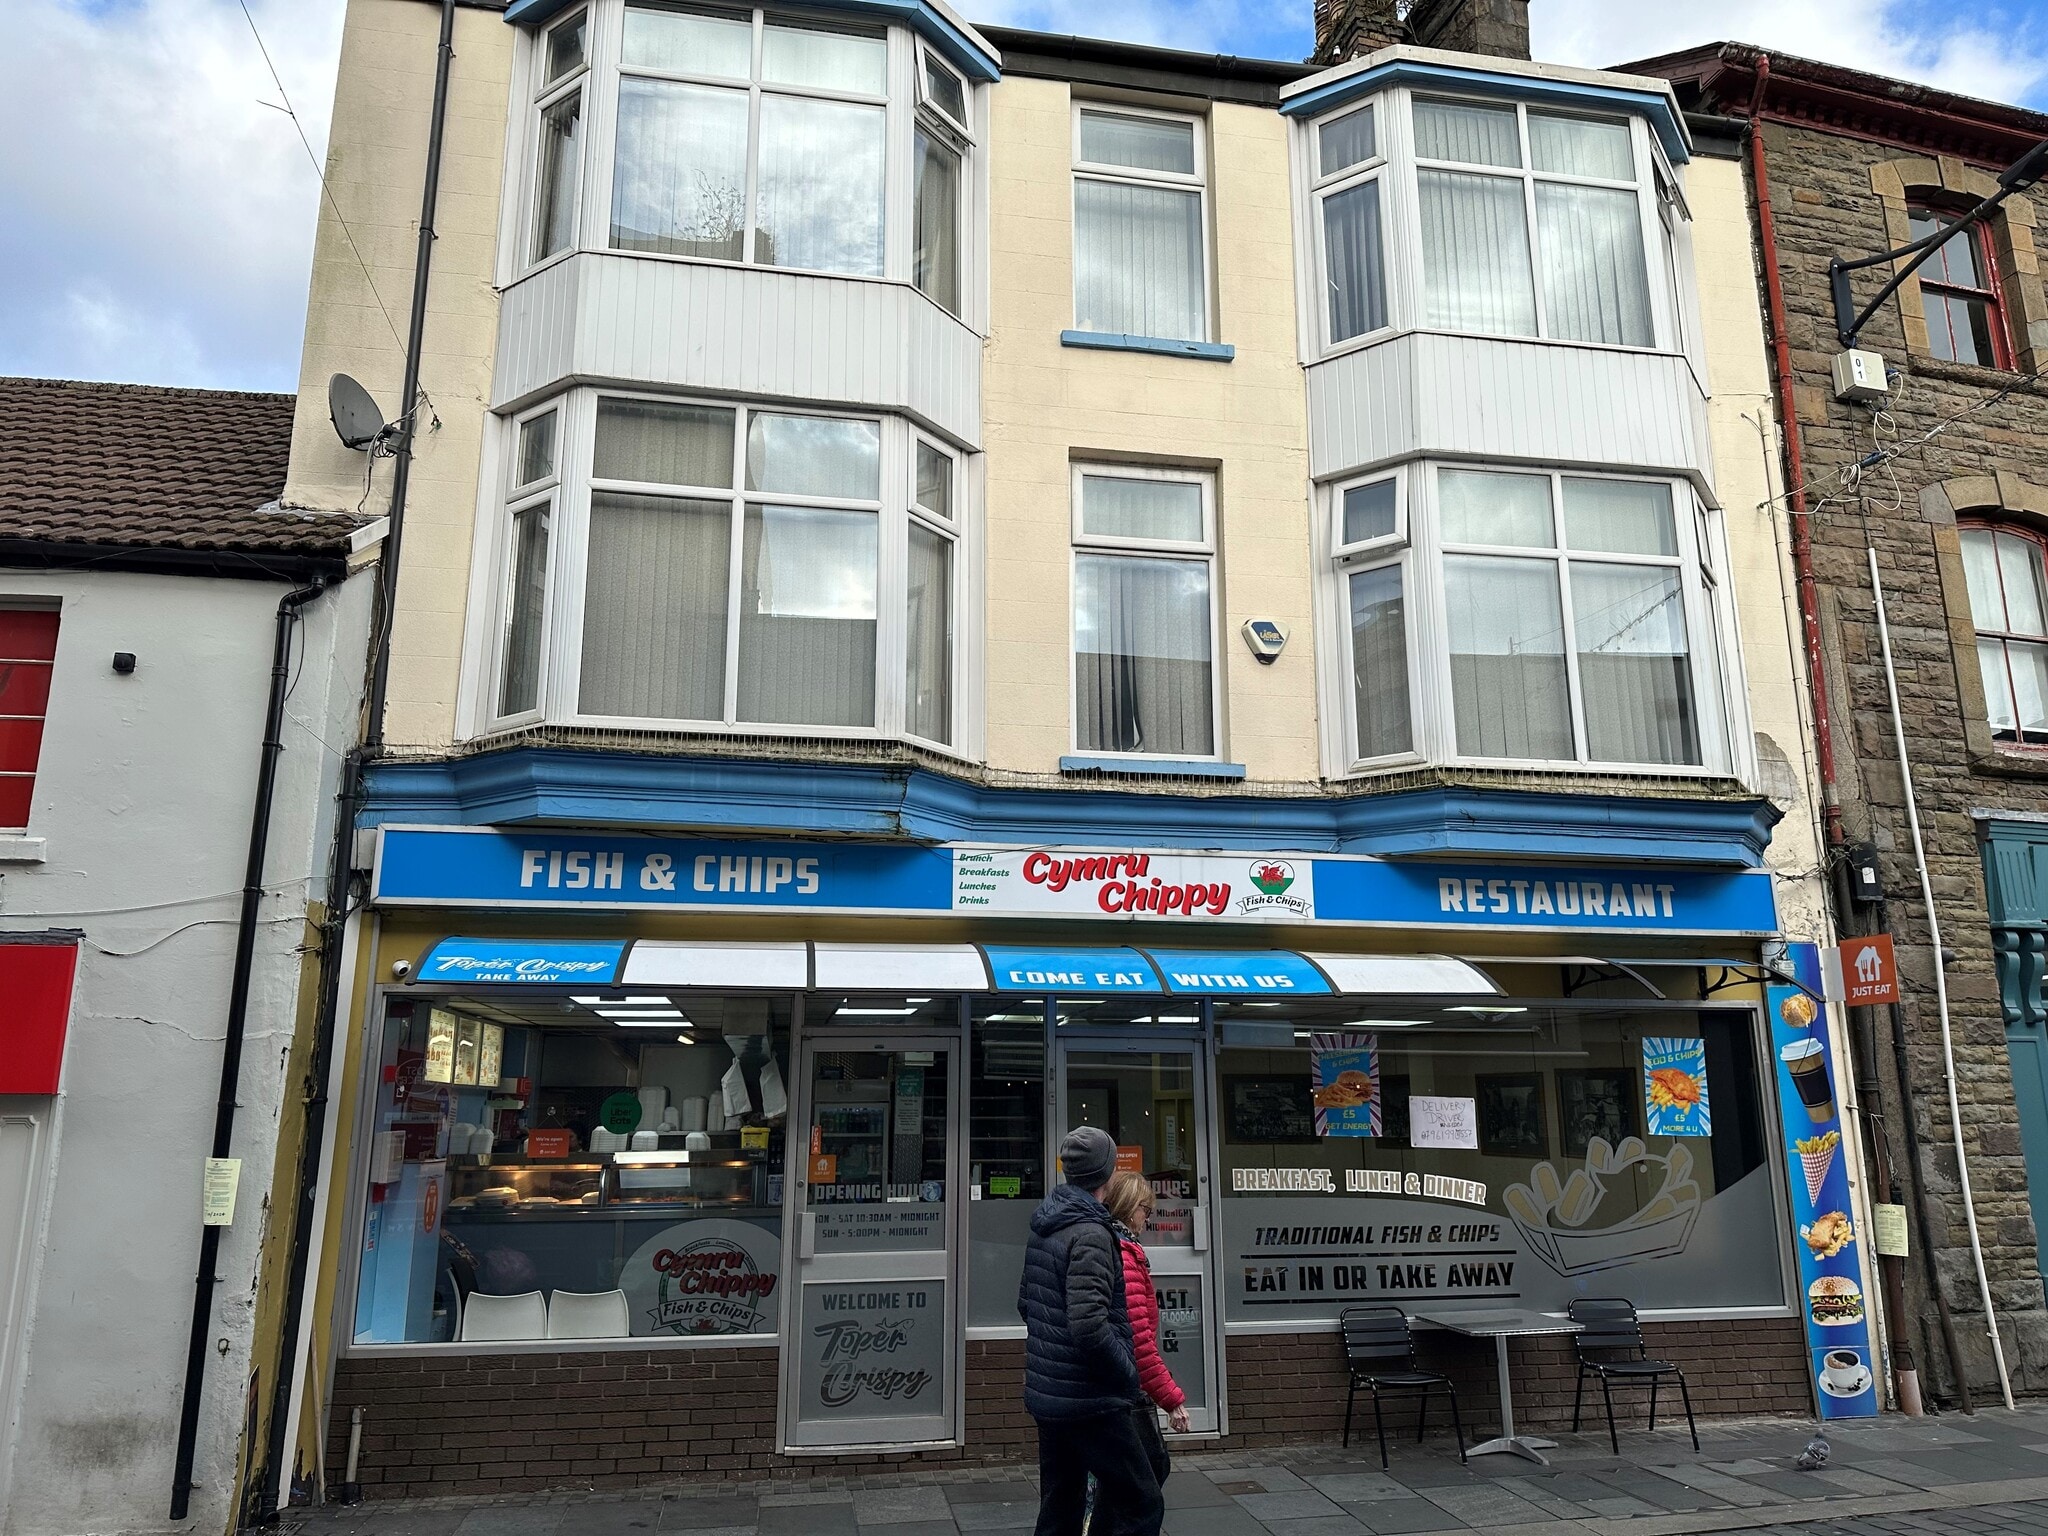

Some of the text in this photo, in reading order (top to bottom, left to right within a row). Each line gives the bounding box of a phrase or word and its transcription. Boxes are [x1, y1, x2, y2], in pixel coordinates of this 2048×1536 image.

[959, 854, 993, 862] Brunch
[521, 850, 819, 894] FISH & CHIPS
[959, 867, 1010, 877] Breakfasts
[1022, 852, 1150, 892] Cymru
[959, 881, 997, 890] Lunches
[959, 896, 990, 904] Drinks
[1098, 877, 1231, 915] Chippy
[1246, 894, 1302, 908] Fish & Chips
[1438, 877, 1674, 917] RESTAURANT
[475, 973, 560, 981] TAKE AWAY
[1009, 971, 1295, 988] COME EAT WITH US
[1852, 984, 1892, 998] JUST EAT
[1343, 1109, 1356, 1118] £5
[1422, 1101, 1466, 1114] DELIVERY
[1325, 1122, 1373, 1130] GET ENERGY
[816, 1183, 923, 1199] OPENING HOU
[1150, 1180, 1190, 1194] OURS
[1232, 1168, 1487, 1205] BREAKFAST, LUNCH & DINNER
[839, 1214, 854, 1223] SAT
[856, 1213, 892, 1222] 10:30AM
[901, 1212, 940, 1221] MIDNIGHT
[822, 1229, 839, 1237] SUN
[848, 1228, 880, 1237] 5:00PM
[889, 1227, 928, 1236] MIDNIGHT
[1255, 1224, 1499, 1245] TRADITIONAL FISH & CHIPS
[653, 1249, 744, 1278] Cymru
[679, 1268, 777, 1298] Chippy
[1244, 1261, 1514, 1292] EAT IN OR TAKE AWAY
[822, 1292, 926, 1310] WELCOME TO
[663, 1301, 752, 1320] Fish & Chips
[1161, 1310, 1199, 1322] FLOODGAT
[813, 1320, 907, 1368] Toper
[1163, 1330, 1179, 1352] &
